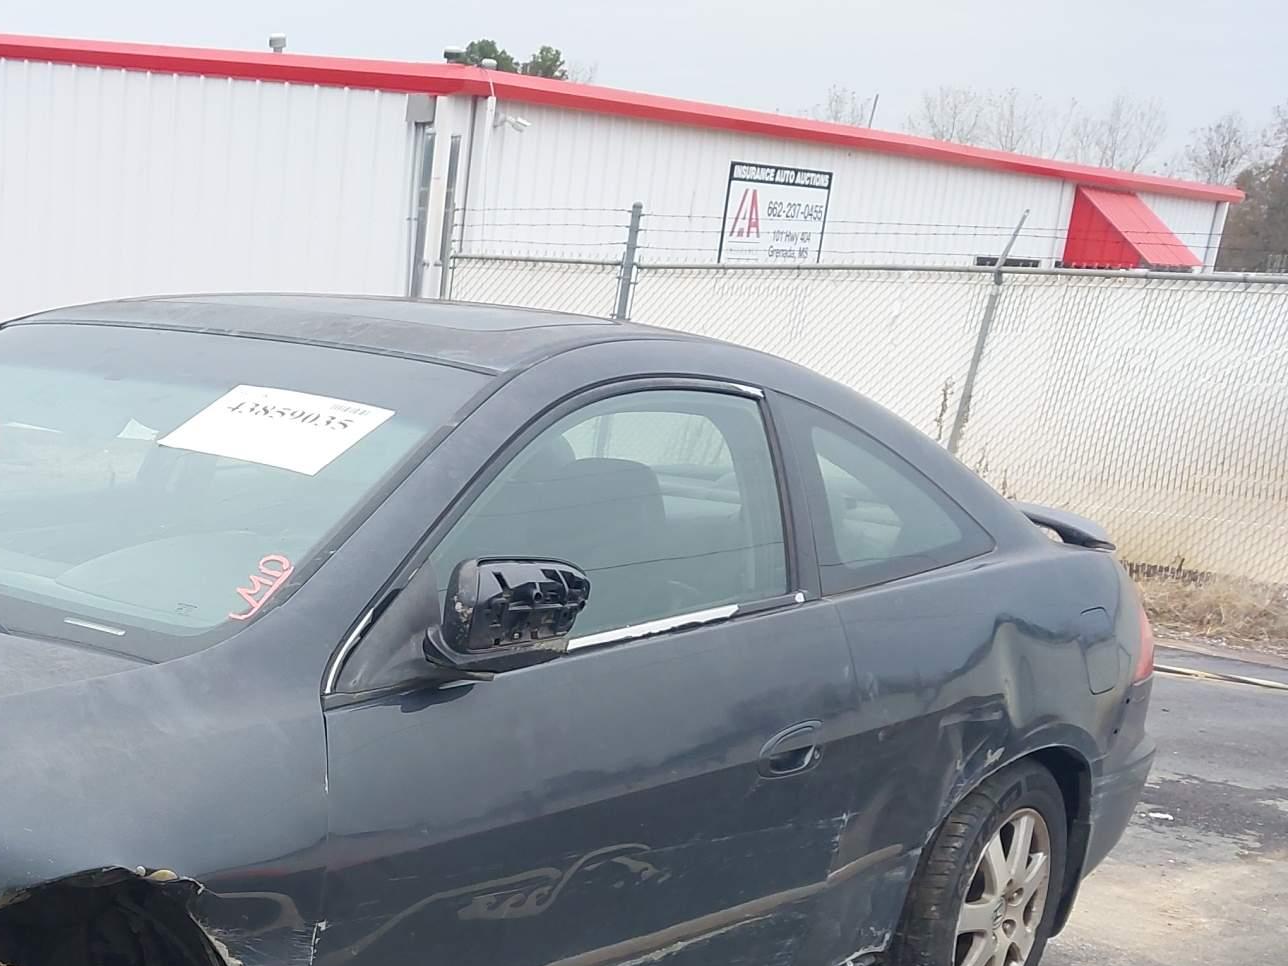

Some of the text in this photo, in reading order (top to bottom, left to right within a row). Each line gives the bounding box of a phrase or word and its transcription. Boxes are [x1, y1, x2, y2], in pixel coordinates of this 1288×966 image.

[734, 165, 830, 187] INSURANCE AUTO AUCTIONS
[767, 201, 824, 220] 662-237-0455
[785, 231, 798, 245] Hwy
[226, 401, 355, 430] 43859035
